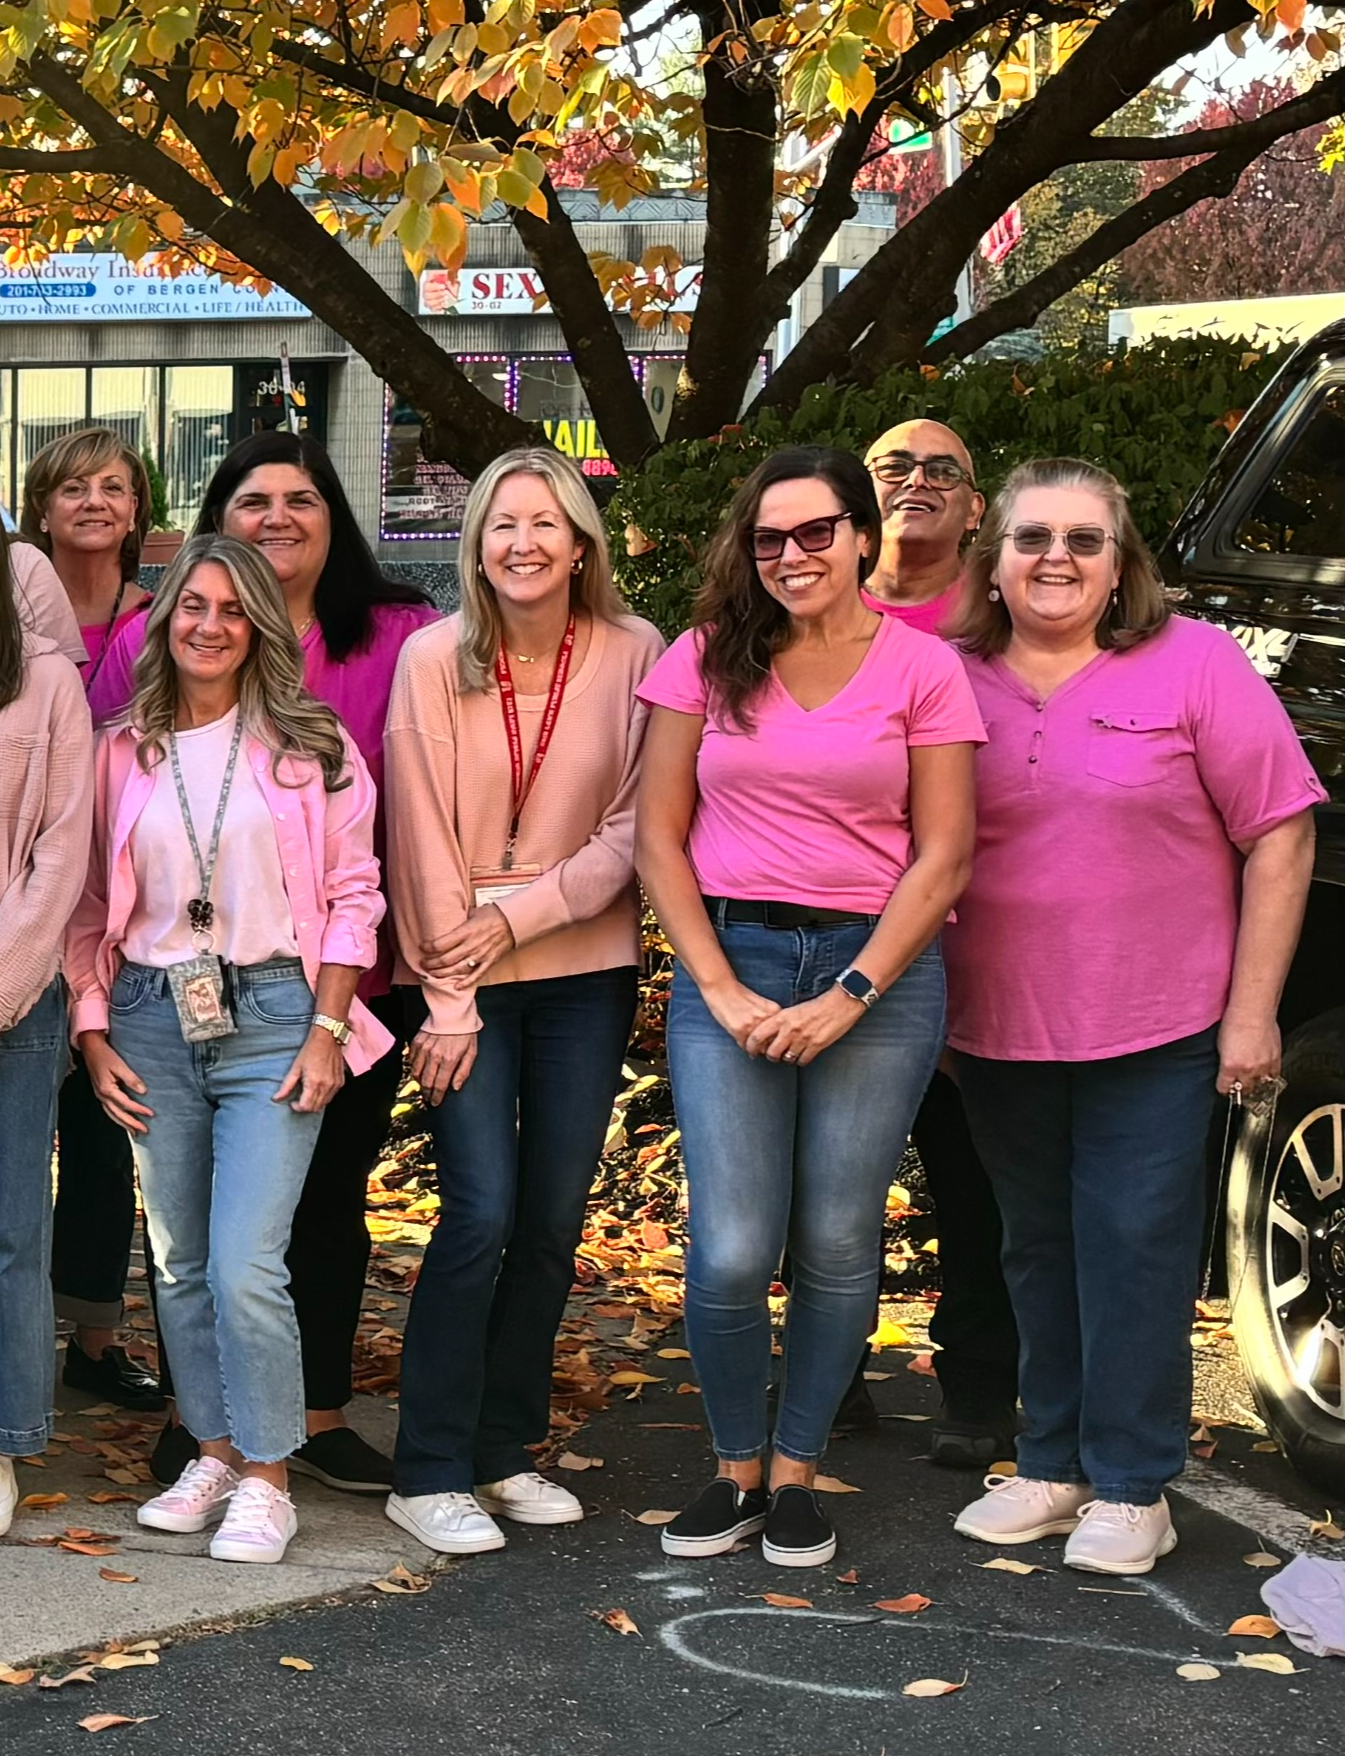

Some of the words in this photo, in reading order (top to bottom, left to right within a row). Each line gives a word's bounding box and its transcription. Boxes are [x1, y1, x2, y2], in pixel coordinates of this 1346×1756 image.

[114, 284, 135, 296] OF
[148, 284, 219, 295] BERGEN
[38, 303, 80, 315] HOME
[91, 302, 190, 314] COMMERCIAL
[203, 302, 232, 313] LIFE
[543, 419, 610, 458] AIL
